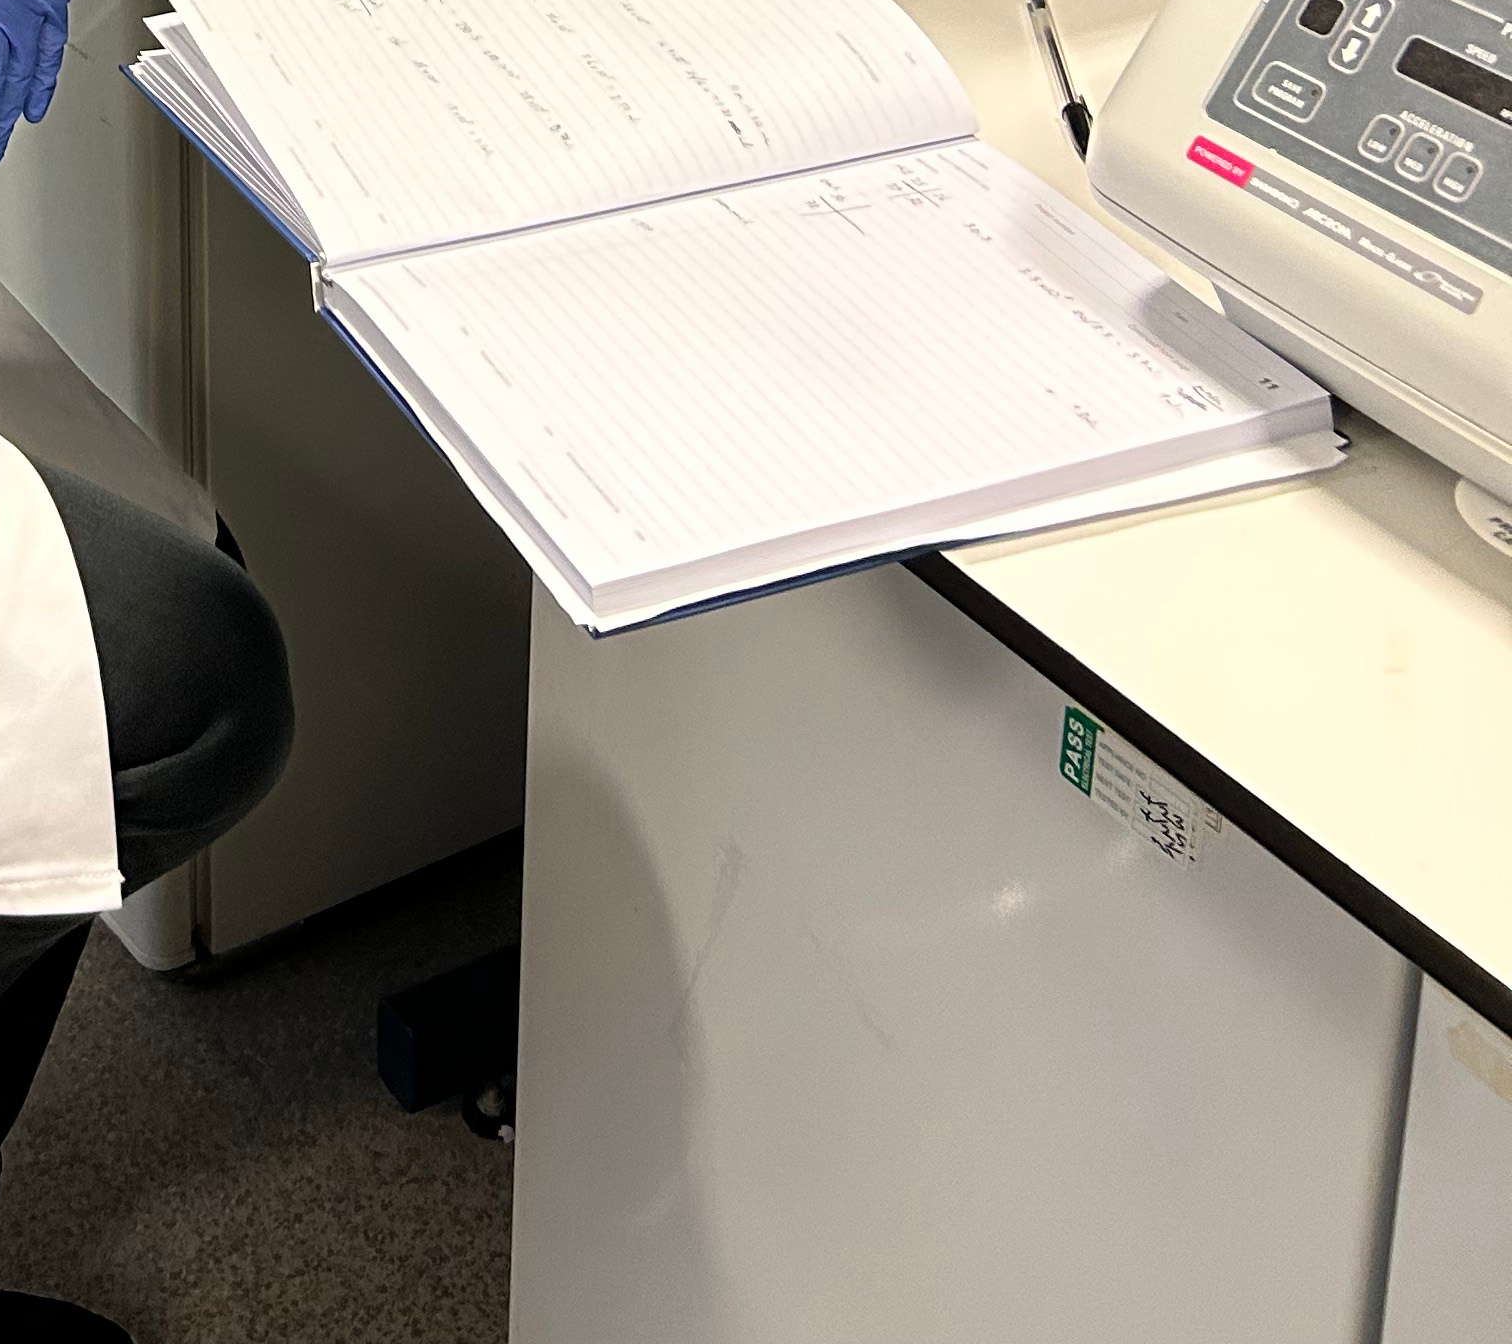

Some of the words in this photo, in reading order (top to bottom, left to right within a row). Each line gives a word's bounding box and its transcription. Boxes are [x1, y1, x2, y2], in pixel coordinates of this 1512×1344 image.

[1465, 43, 1498, 64] SPEED
[1268, 84, 1306, 109] PROGRAM
[1399, 109, 1476, 153] ACCELERATION
[1194, 145, 1233, 172] POWERED
[1232, 166, 1246, 177] BY
[1258, 377, 1280, 391] 11
[1064, 716, 1085, 784] PASS
